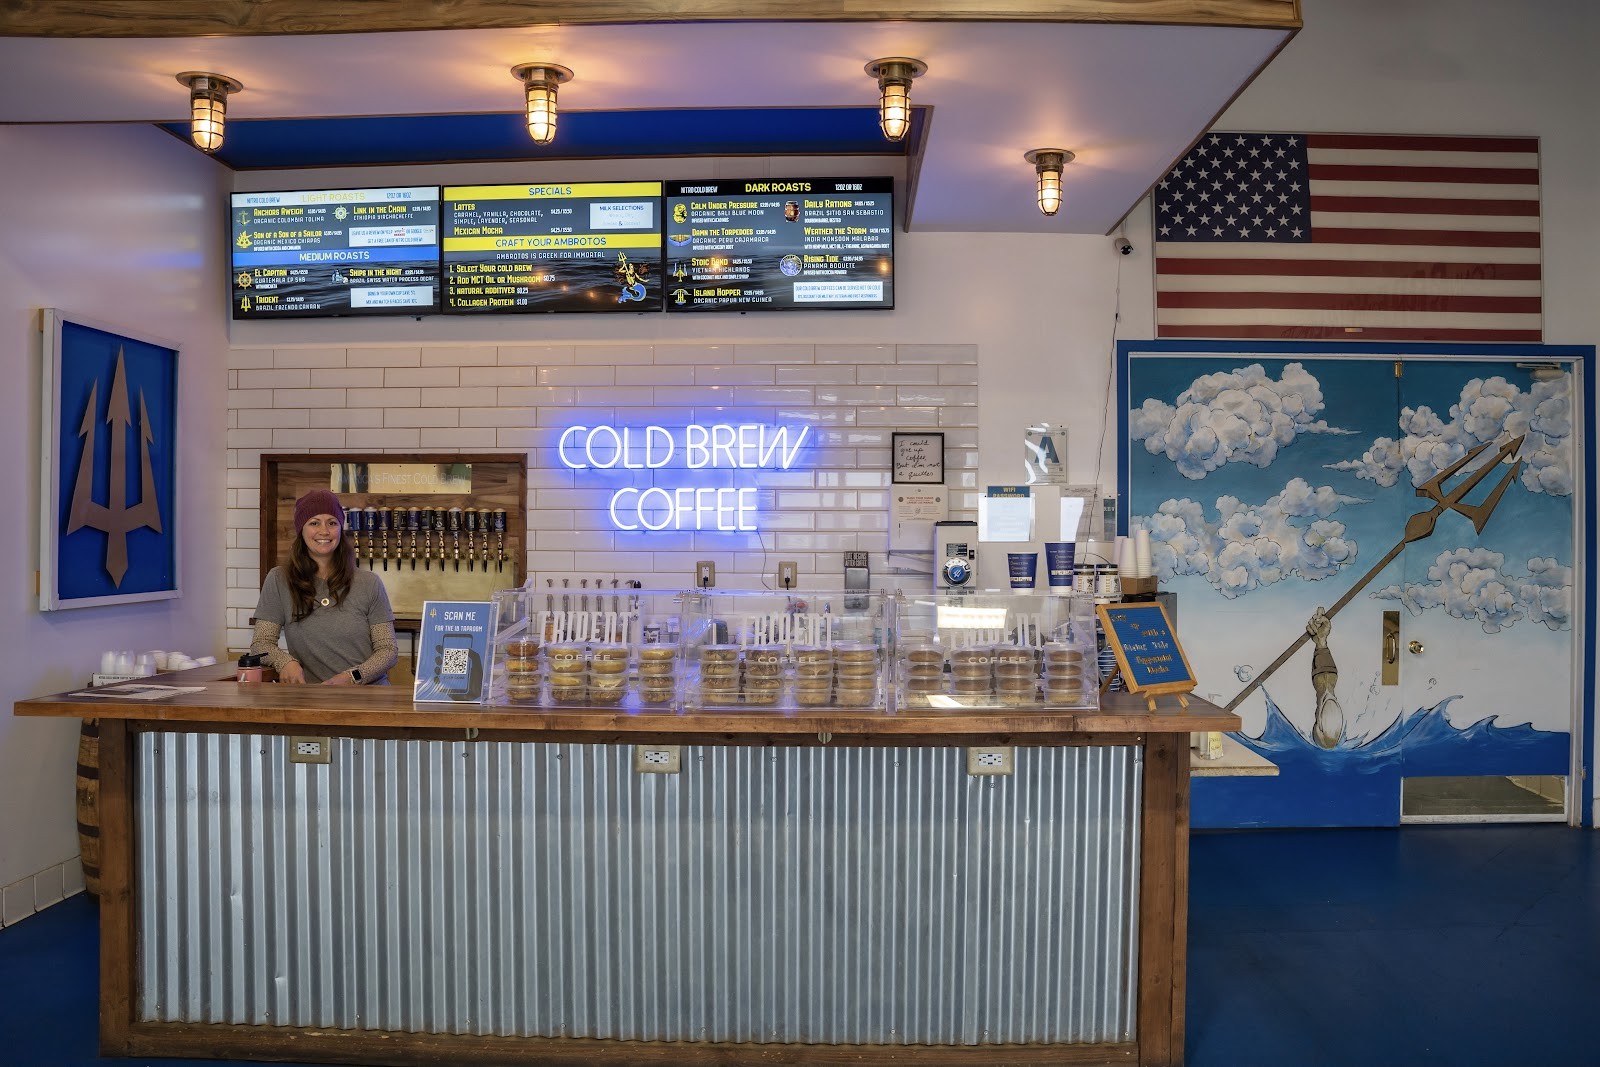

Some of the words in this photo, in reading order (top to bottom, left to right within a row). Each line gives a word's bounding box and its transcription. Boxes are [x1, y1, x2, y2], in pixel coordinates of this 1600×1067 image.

[529, 187, 571, 195] SPECIALS
[745, 183, 770, 192] DARK
[772, 183, 811, 192] ROASTS
[302, 194, 327, 202] LIGHT
[329, 192, 365, 202] ROASTS
[805, 200, 823, 208] DAILY
[825, 200, 852, 208] RATIONS
[254, 208, 279, 216] ANCHORS
[354, 206, 366, 214] LINK
[454, 227, 480, 235] MEXICAN
[482, 226, 503, 234] MOCHA
[804, 227, 833, 235] WEATHER
[496, 239, 524, 247] CRAFT
[554, 237, 606, 246] AMBROTOS
[300, 253, 332, 261] MEDIUM
[334, 251, 370, 260] ROASTS
[692, 258, 709, 266] STOIC
[457, 276, 469, 284] ADD
[471, 276, 484, 284] MCT
[507, 275, 541, 283] MUSHROOM
[694, 288, 715, 296] ISLAND
[717, 288, 740, 296] HOPPER
[559, 426, 674, 469] COLD
[686, 424, 809, 469] BREW
[1035, 436, 1060, 463] A
[382, 473, 411, 485] FINEST
[413, 473, 438, 485] COLD
[440, 473, 465, 485] BREW
[610, 487, 758, 530] COFFEE
[444, 612, 464, 620] SCAN
[466, 612, 476, 620] ME
[538, 611, 632, 649] TRIDENT
